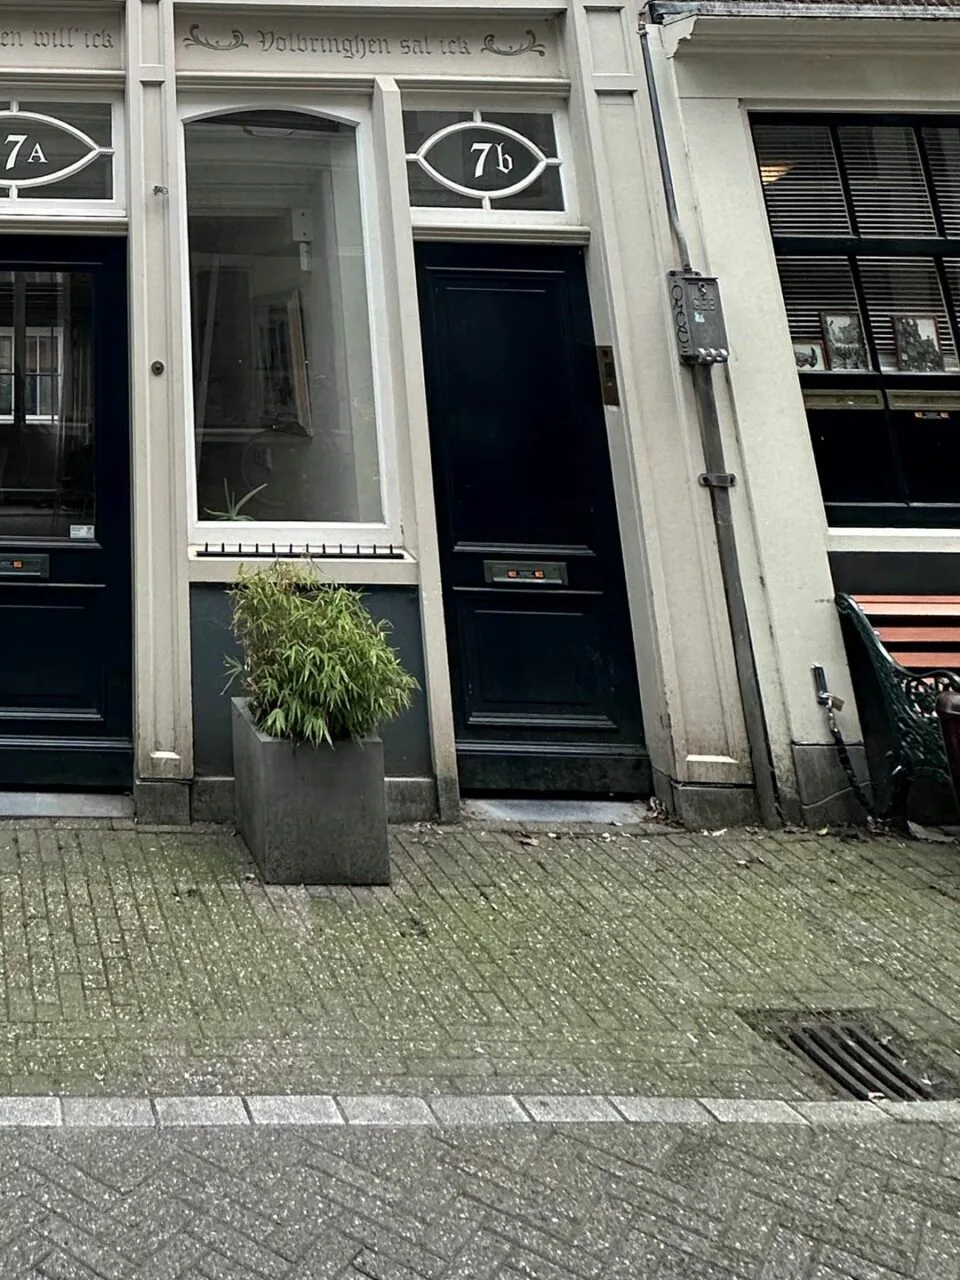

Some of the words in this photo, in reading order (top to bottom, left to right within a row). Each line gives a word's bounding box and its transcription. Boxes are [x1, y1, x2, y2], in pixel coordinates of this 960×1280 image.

[84, 28, 115, 49] ick
[257, 30, 391, 59] Volbringhen
[440, 35, 472, 56] ick
[470, 142, 514, 178] 7b
